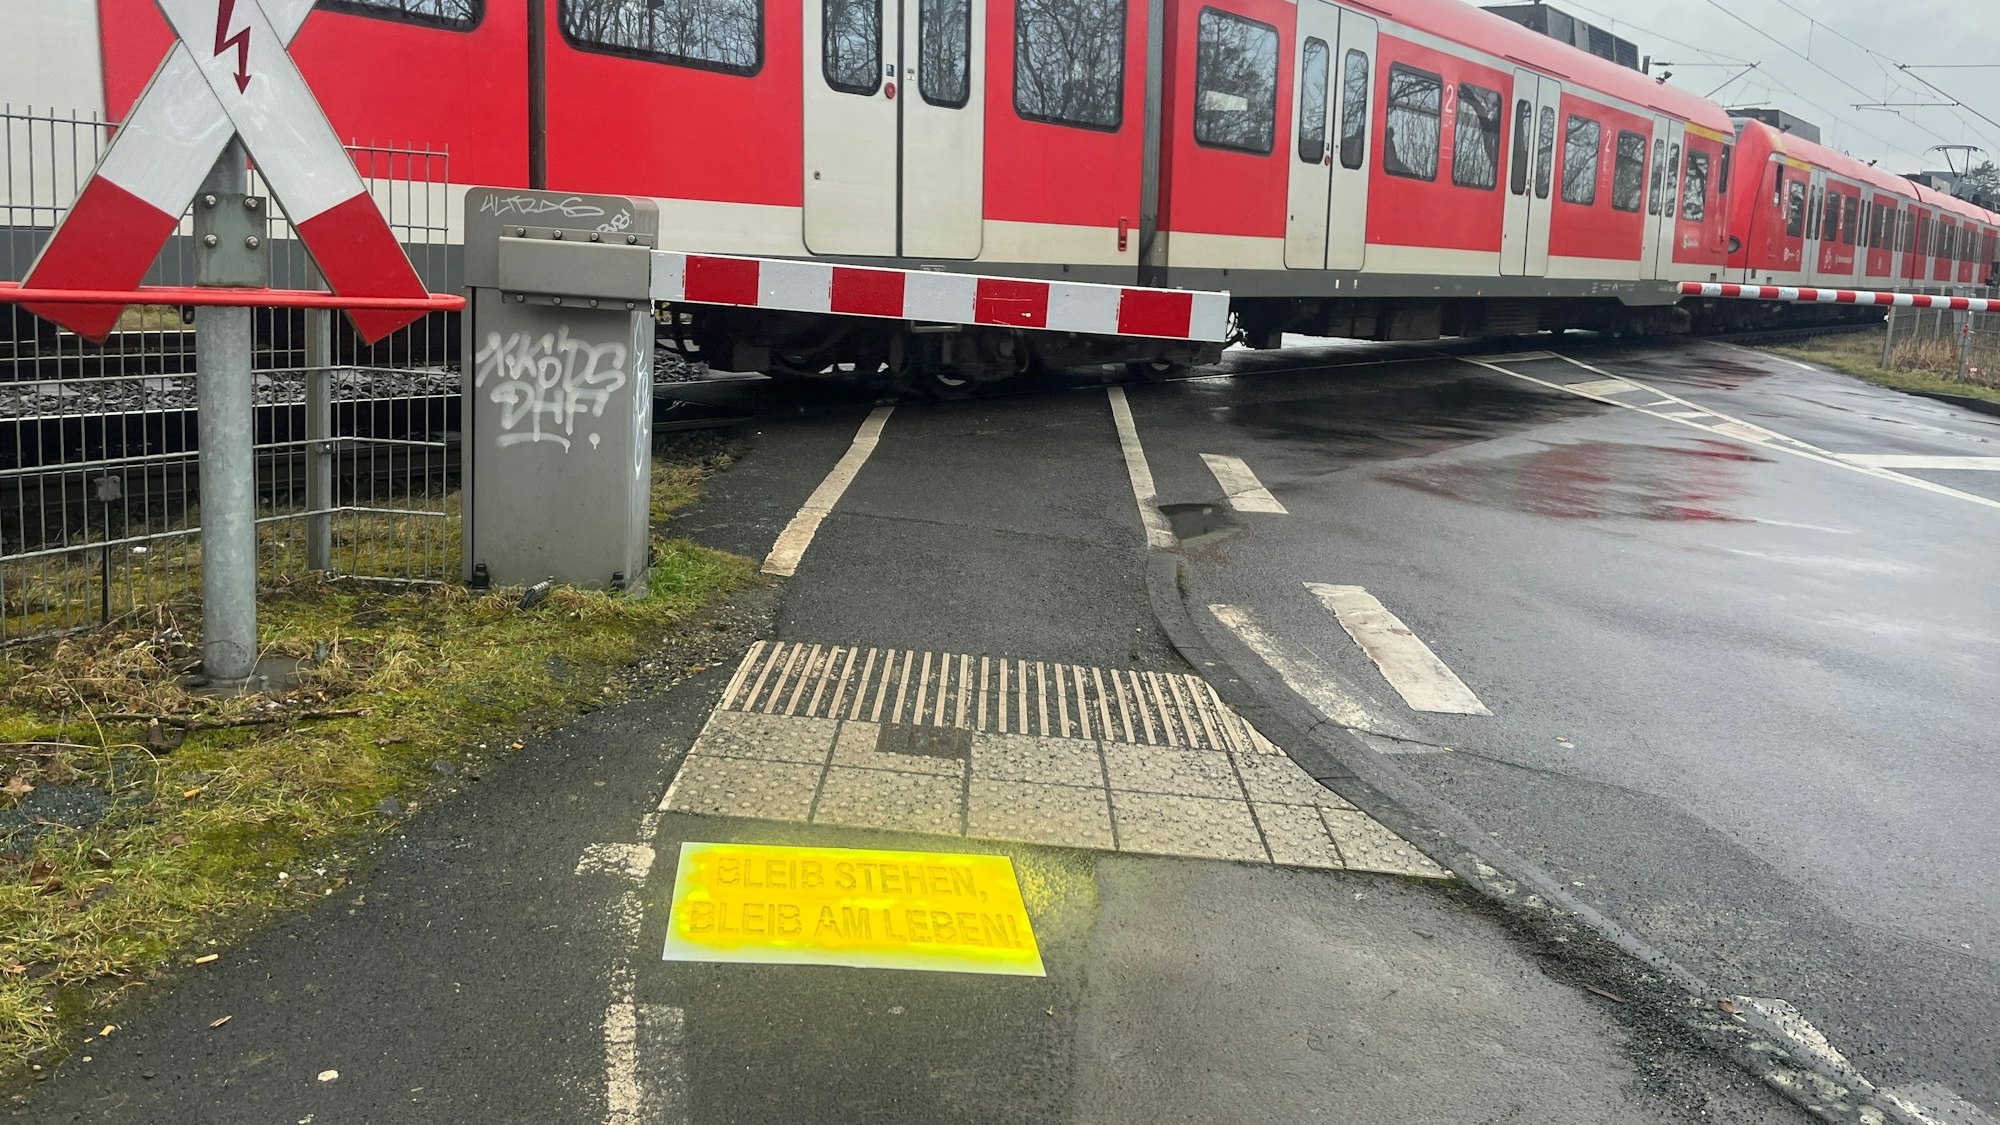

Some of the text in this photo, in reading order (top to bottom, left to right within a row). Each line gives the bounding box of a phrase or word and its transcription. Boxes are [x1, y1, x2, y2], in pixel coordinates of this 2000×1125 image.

[1444, 84, 1454, 114] 2
[1604, 129, 1612, 153] 2
[718, 858, 988, 904] BLEIB STEHEN,
[689, 900, 1023, 950] BLEIB AM LEBEN!
